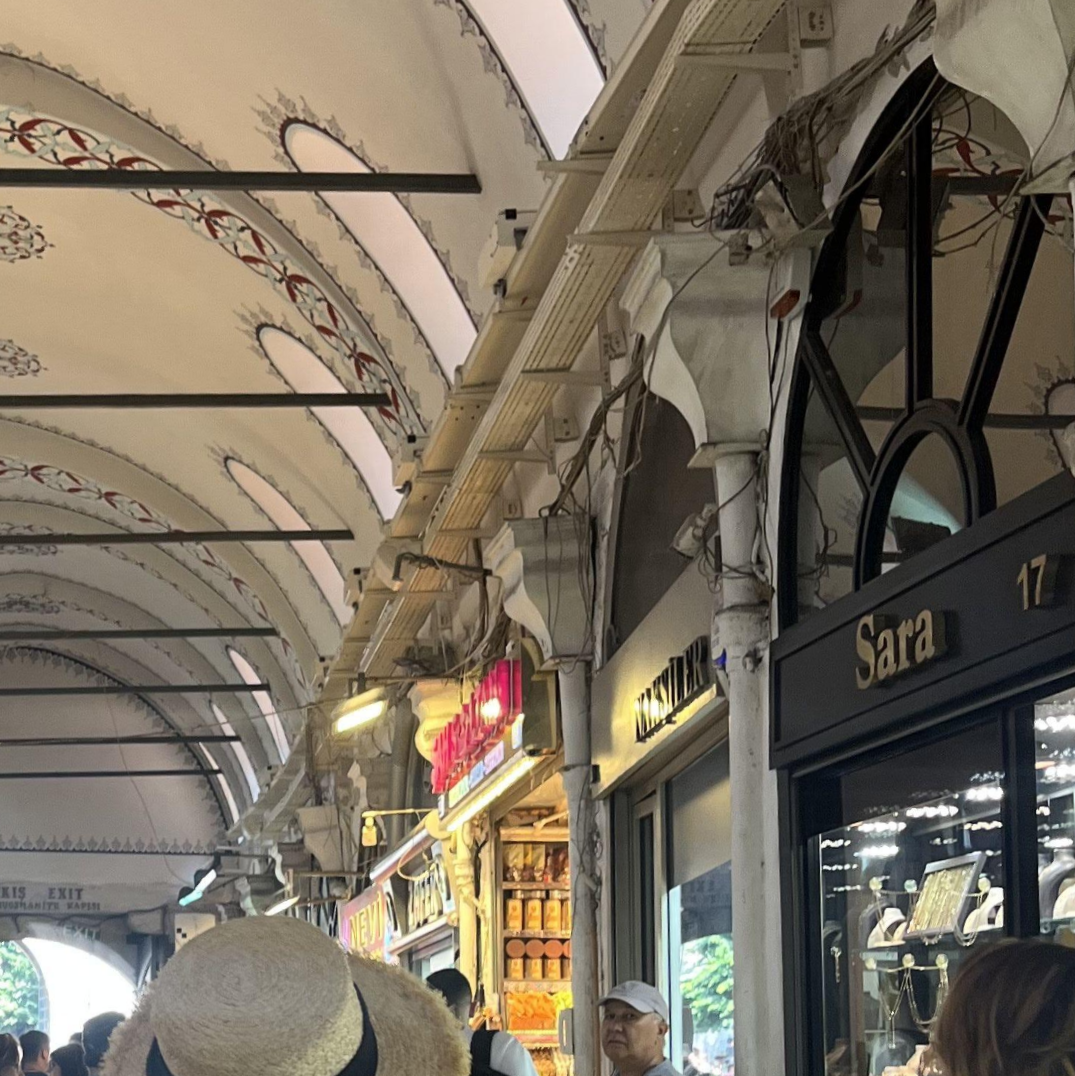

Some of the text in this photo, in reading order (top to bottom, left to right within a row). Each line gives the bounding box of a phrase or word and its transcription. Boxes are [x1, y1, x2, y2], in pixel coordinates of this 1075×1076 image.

[1017, 554, 1047, 610] 17
[855, 609, 936, 690] Sara
[48, 887, 84, 901] EXIT
